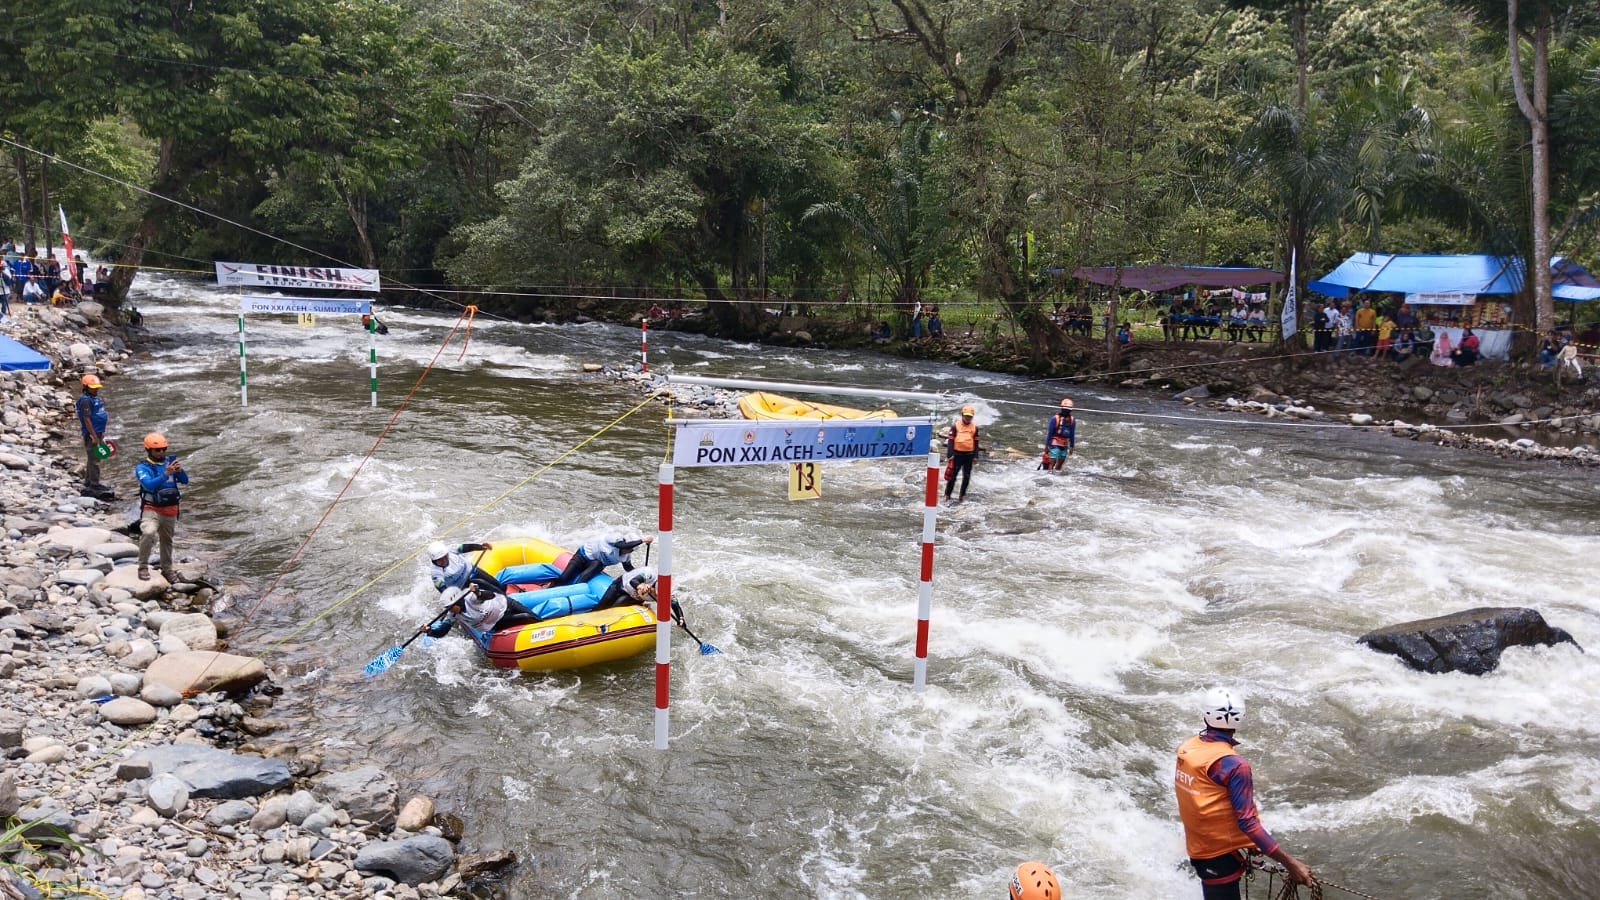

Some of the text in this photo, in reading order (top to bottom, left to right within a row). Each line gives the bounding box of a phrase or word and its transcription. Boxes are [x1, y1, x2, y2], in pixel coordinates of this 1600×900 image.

[256, 265, 342, 283] FINISH
[302, 313, 312, 323] 14
[313, 305, 341, 313] SUMUT
[697, 447, 735, 463] PON
[740, 446, 767, 461] XXI
[771, 445, 813, 460] ACEH
[826, 443, 878, 459] SUMUT
[880, 442, 913, 456] 2024
[796, 462, 814, 491] 13
